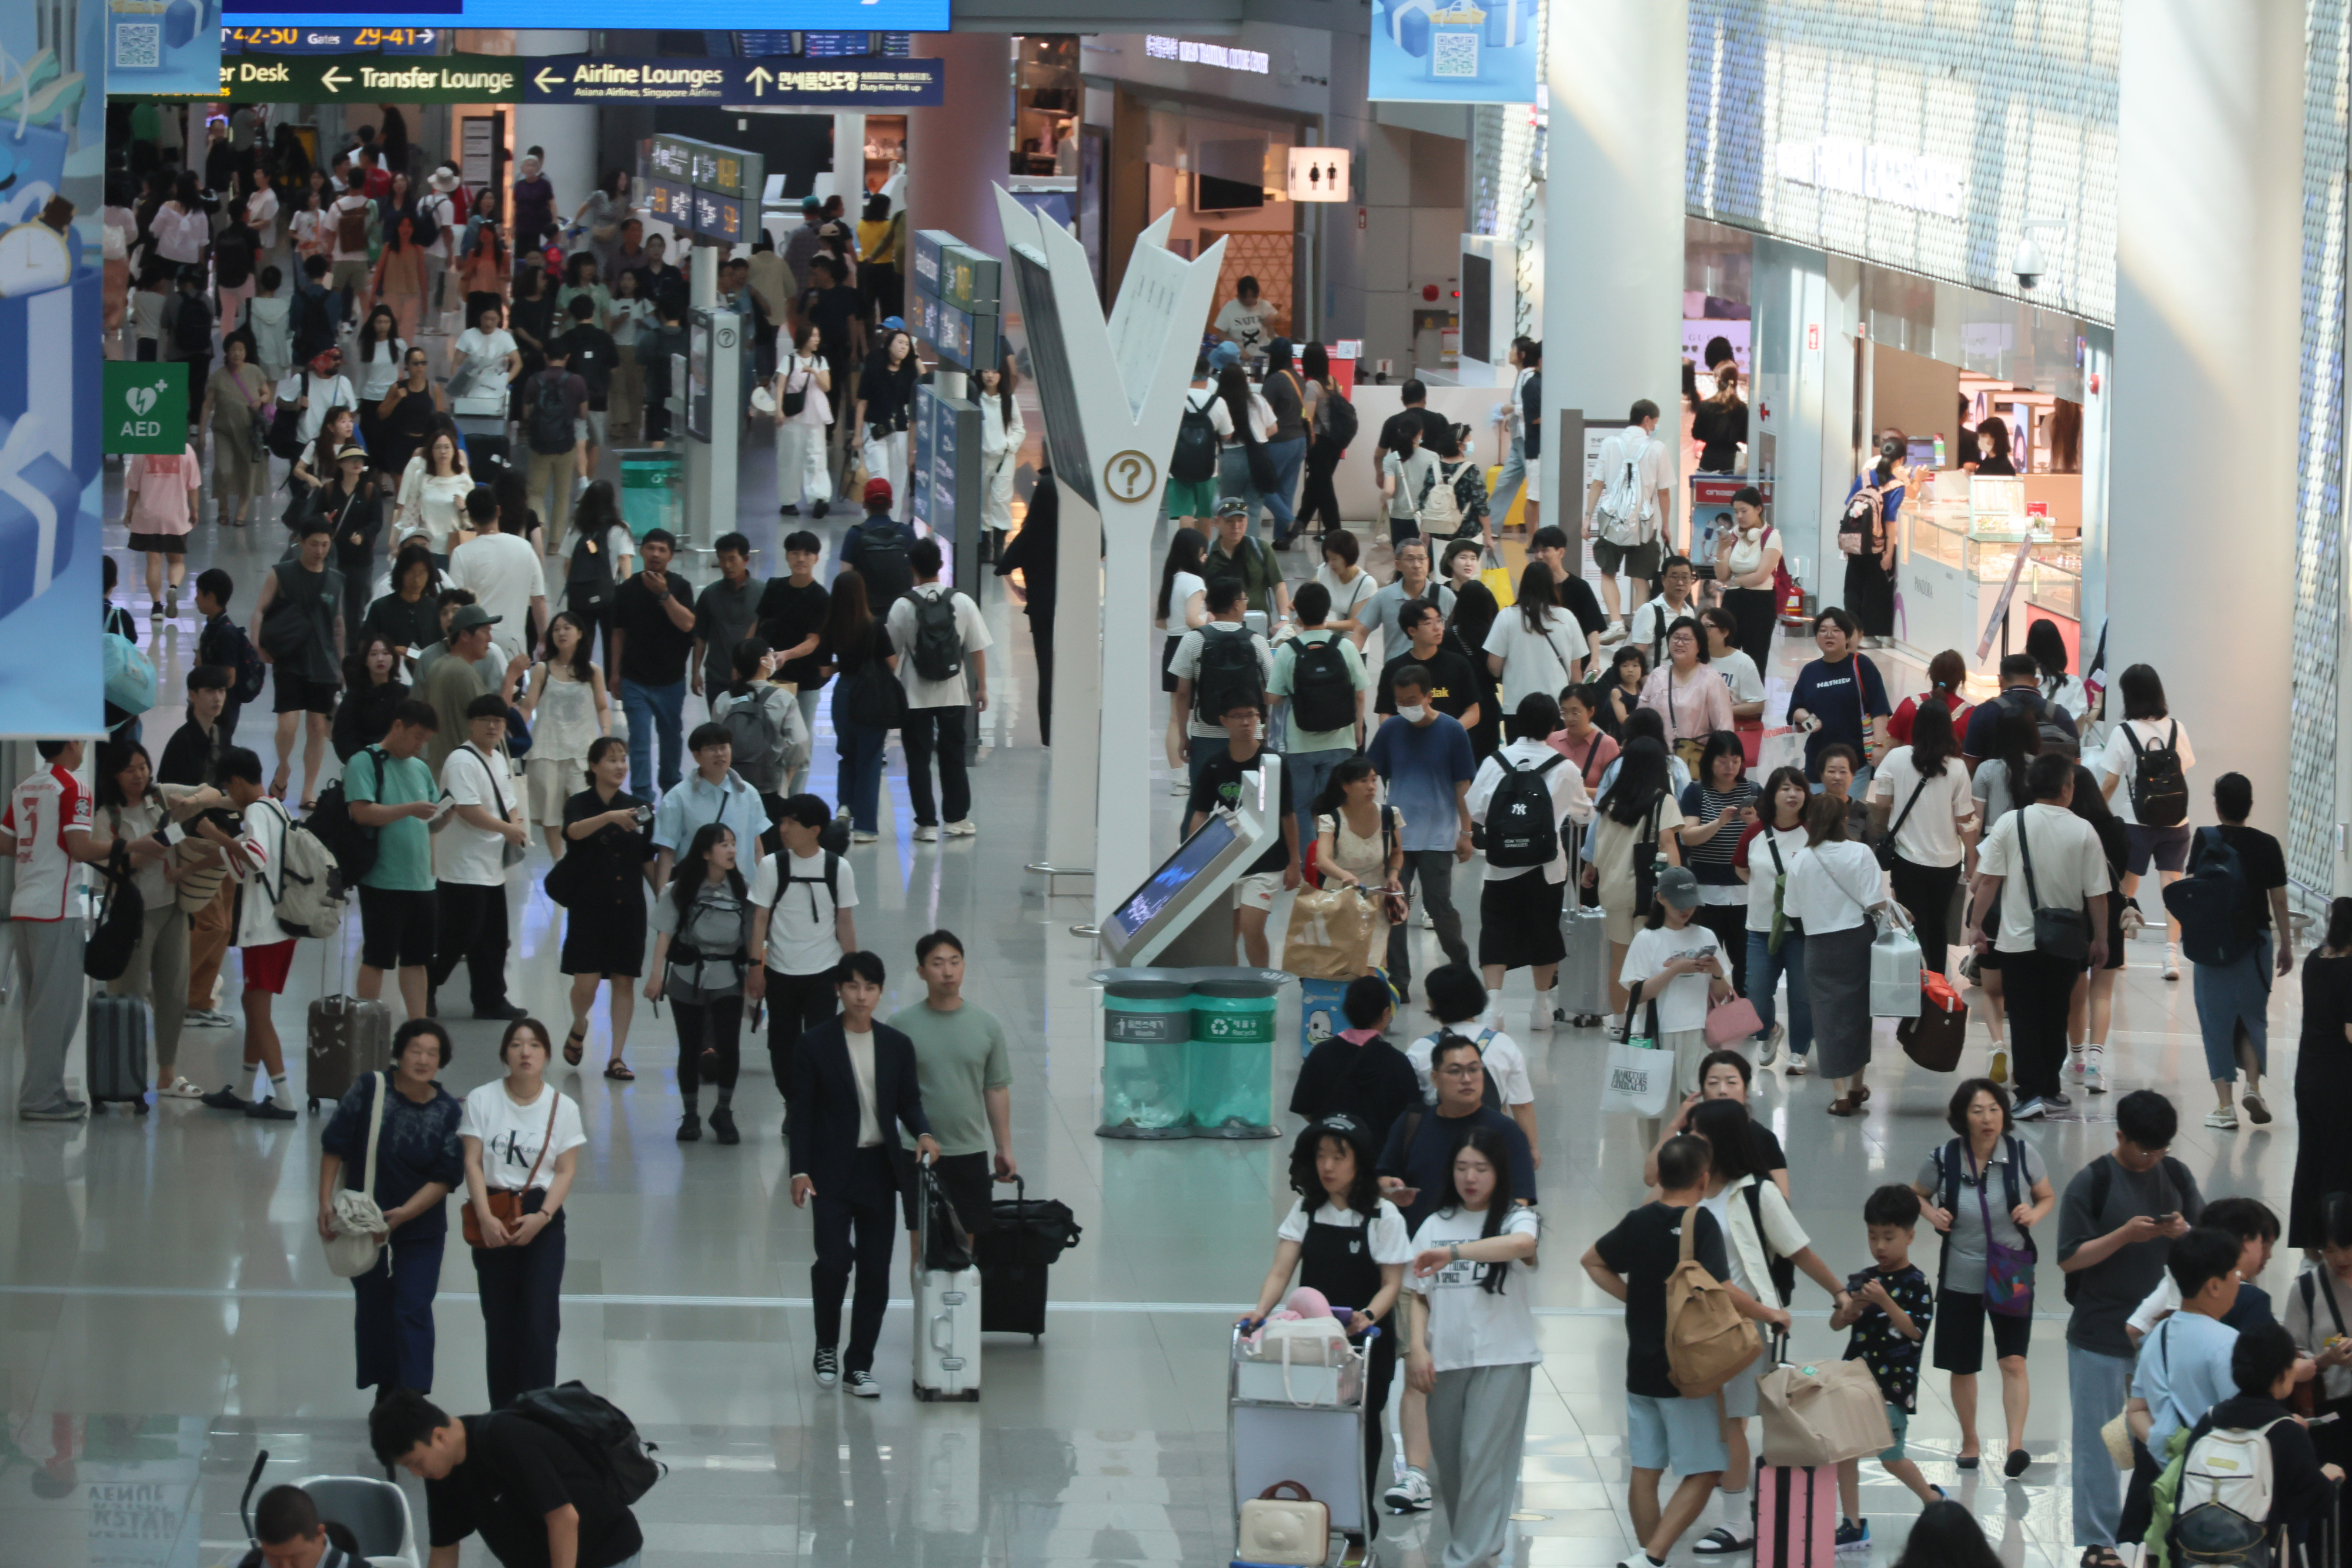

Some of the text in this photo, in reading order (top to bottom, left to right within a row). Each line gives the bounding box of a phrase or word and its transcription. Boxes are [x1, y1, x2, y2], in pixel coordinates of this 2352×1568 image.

[219, 62, 290, 82] er Desk
[360, 66, 514, 93] Transfer Lounge
[573, 63, 723, 88] Airline Lounges
[778, 71, 859, 91] 면세품인도장
[574, 88, 604, 96] Asiana
[860, 83, 878, 92] Duty
[121, 421, 161, 436] AED
